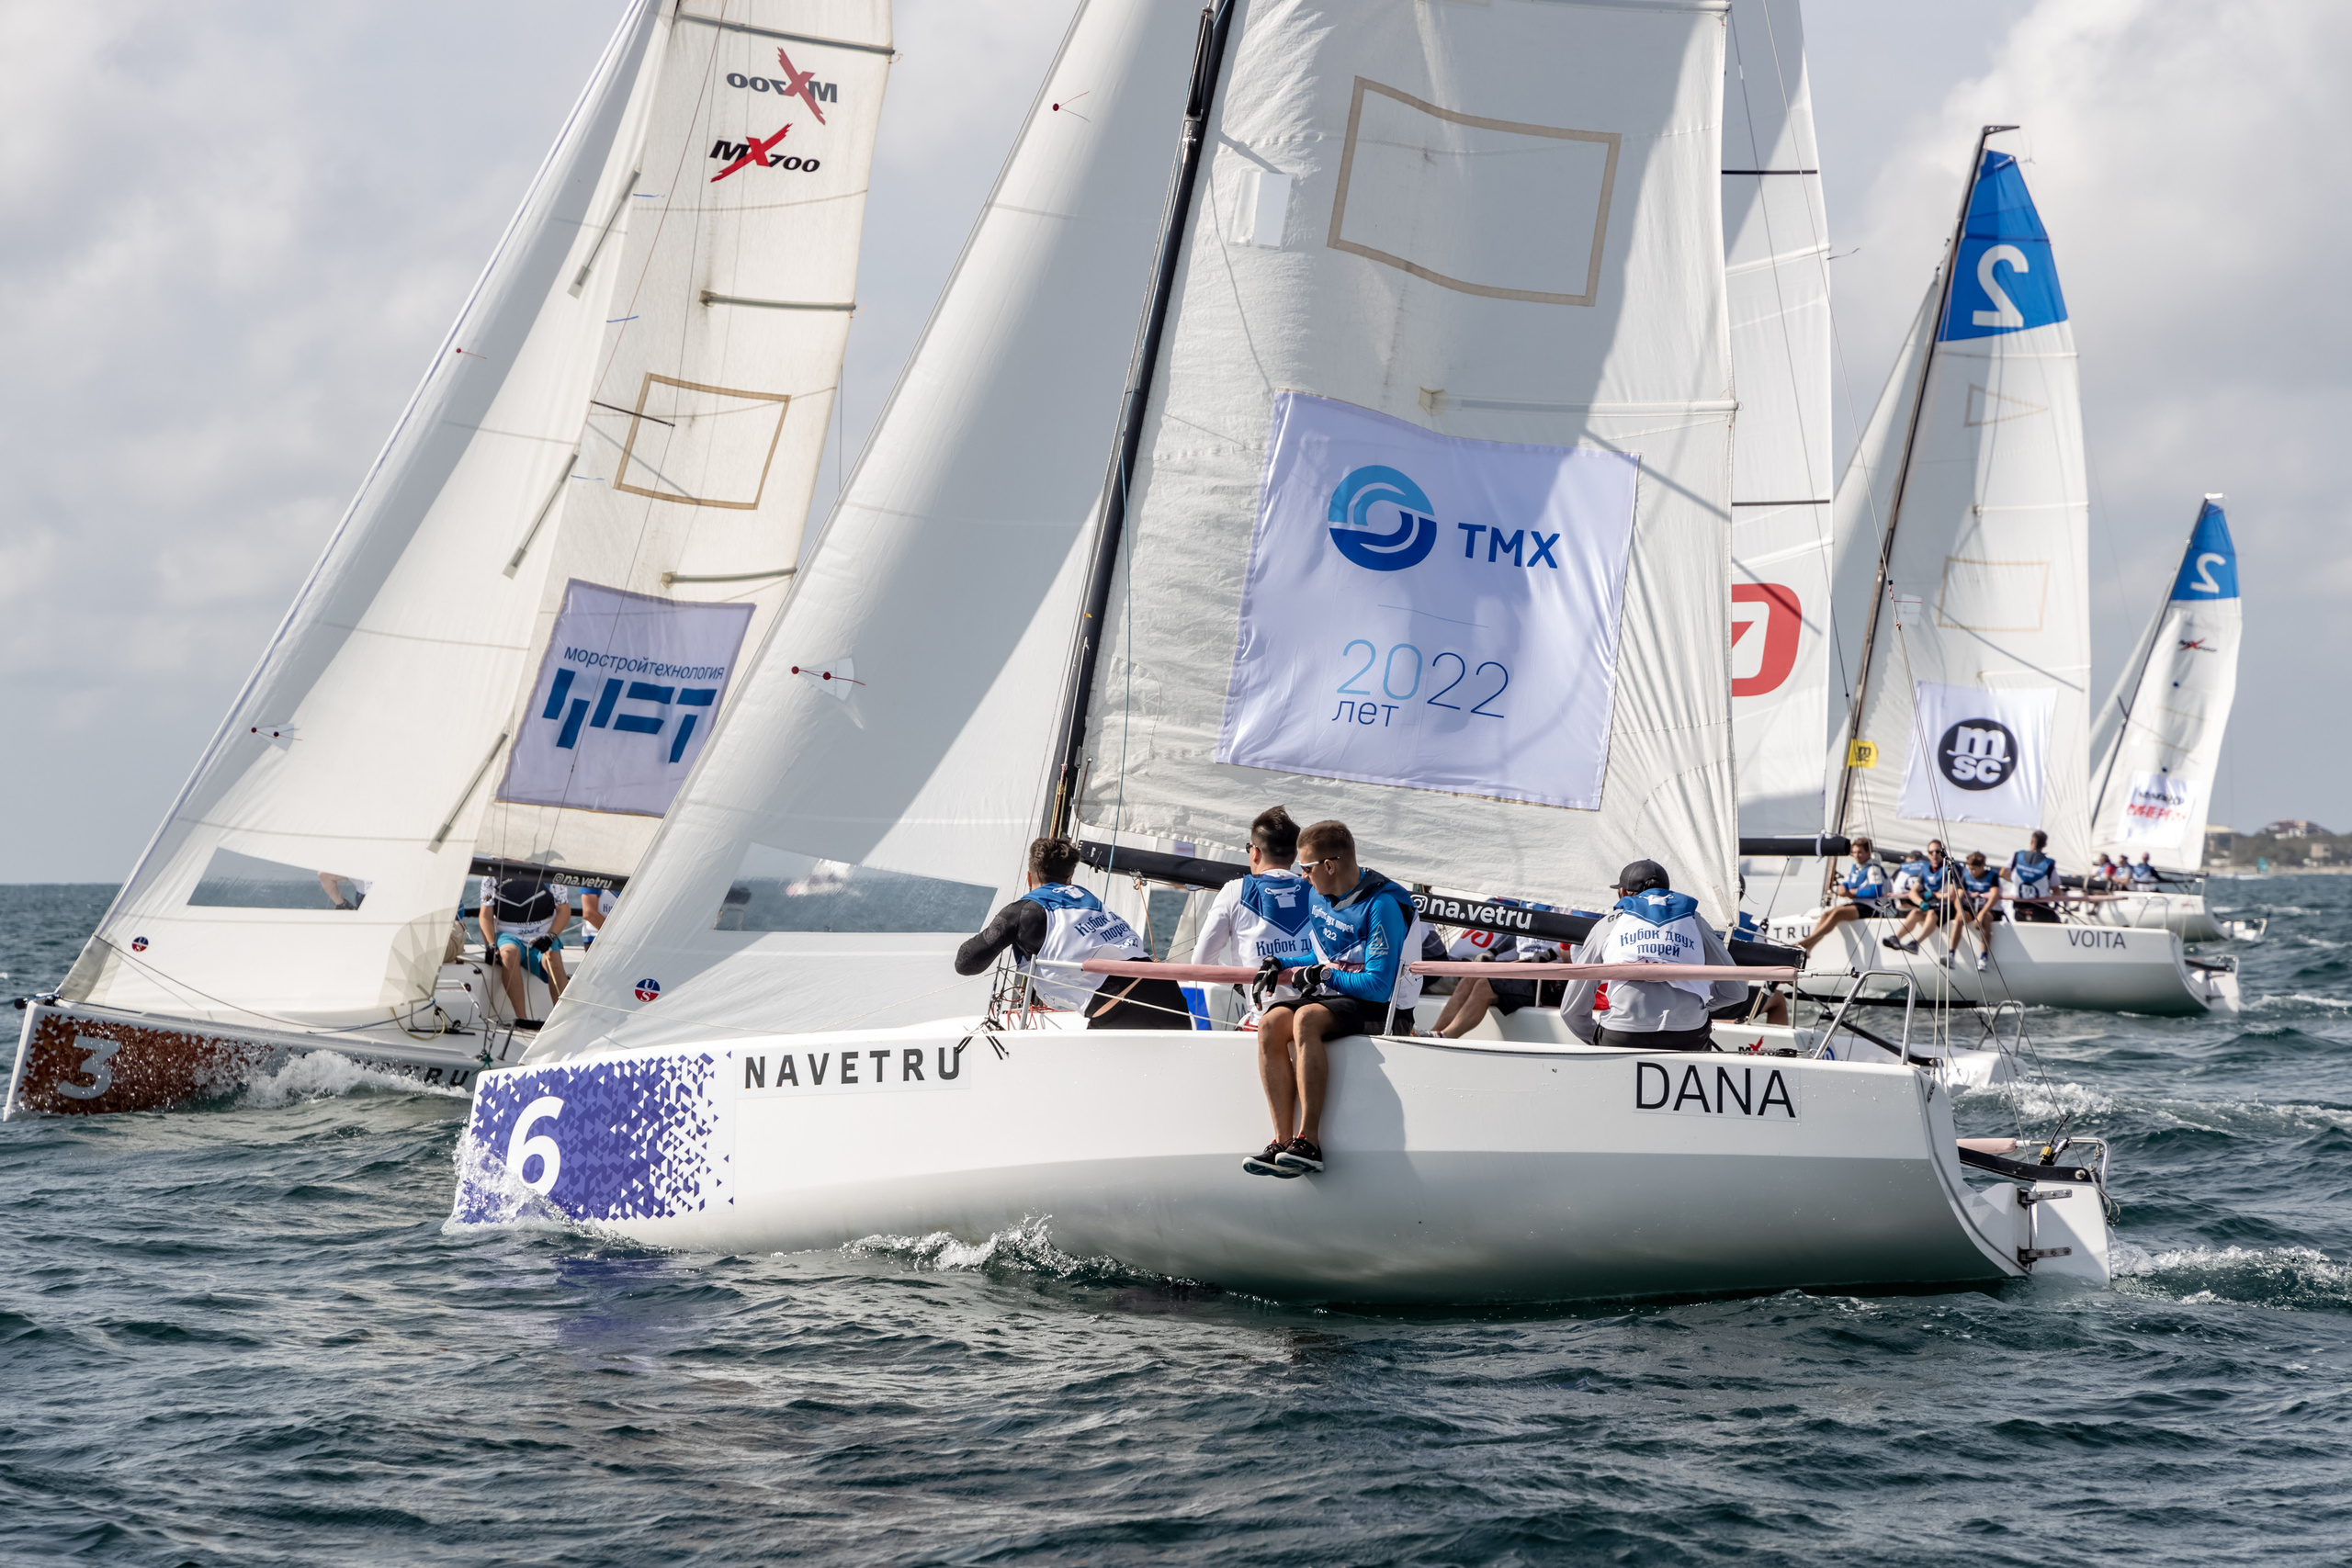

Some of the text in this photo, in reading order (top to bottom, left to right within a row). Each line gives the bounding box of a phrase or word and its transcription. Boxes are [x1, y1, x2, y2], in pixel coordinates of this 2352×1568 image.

[709, 123, 820, 183] MX700
[1331, 701, 1400, 728] лет
[1074, 913, 1109, 937] Кубок
[1256, 939, 1297, 956] Кубок
[1620, 928, 1695, 950] Кубок двух
[1637, 943, 1680, 958] морей
[2067, 930, 2127, 949] VOITA
[57, 1035, 122, 1100] 3
[744, 1046, 961, 1089] NAVETRU
[1635, 1061, 1797, 1119] DANA
[505, 1095, 565, 1197] 6
